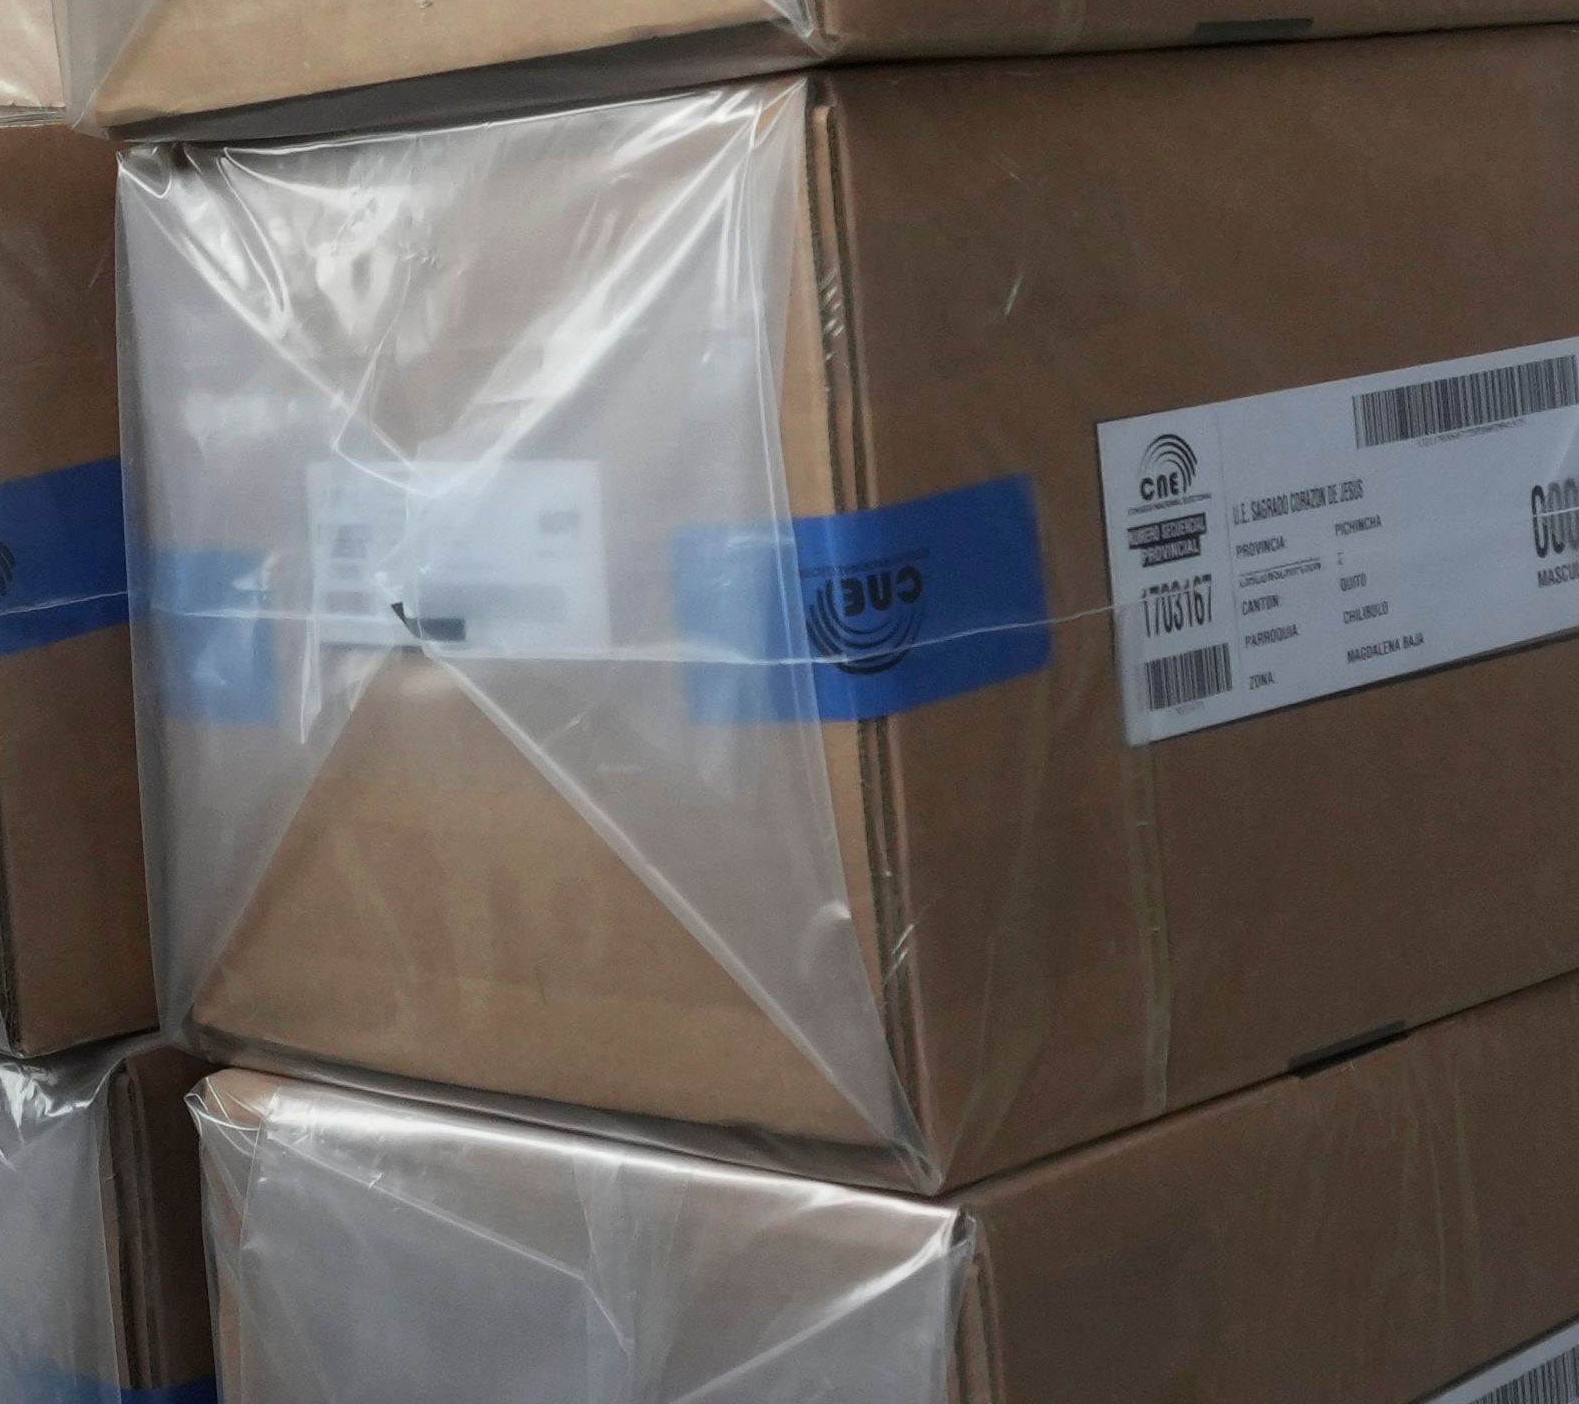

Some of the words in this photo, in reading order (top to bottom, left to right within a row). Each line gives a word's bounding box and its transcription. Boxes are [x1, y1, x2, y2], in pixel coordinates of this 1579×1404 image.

[1140, 472, 1179, 500] CNE
[1251, 496, 1289, 519] SAGRADO
[1141, 574, 1213, 638] 1703167
